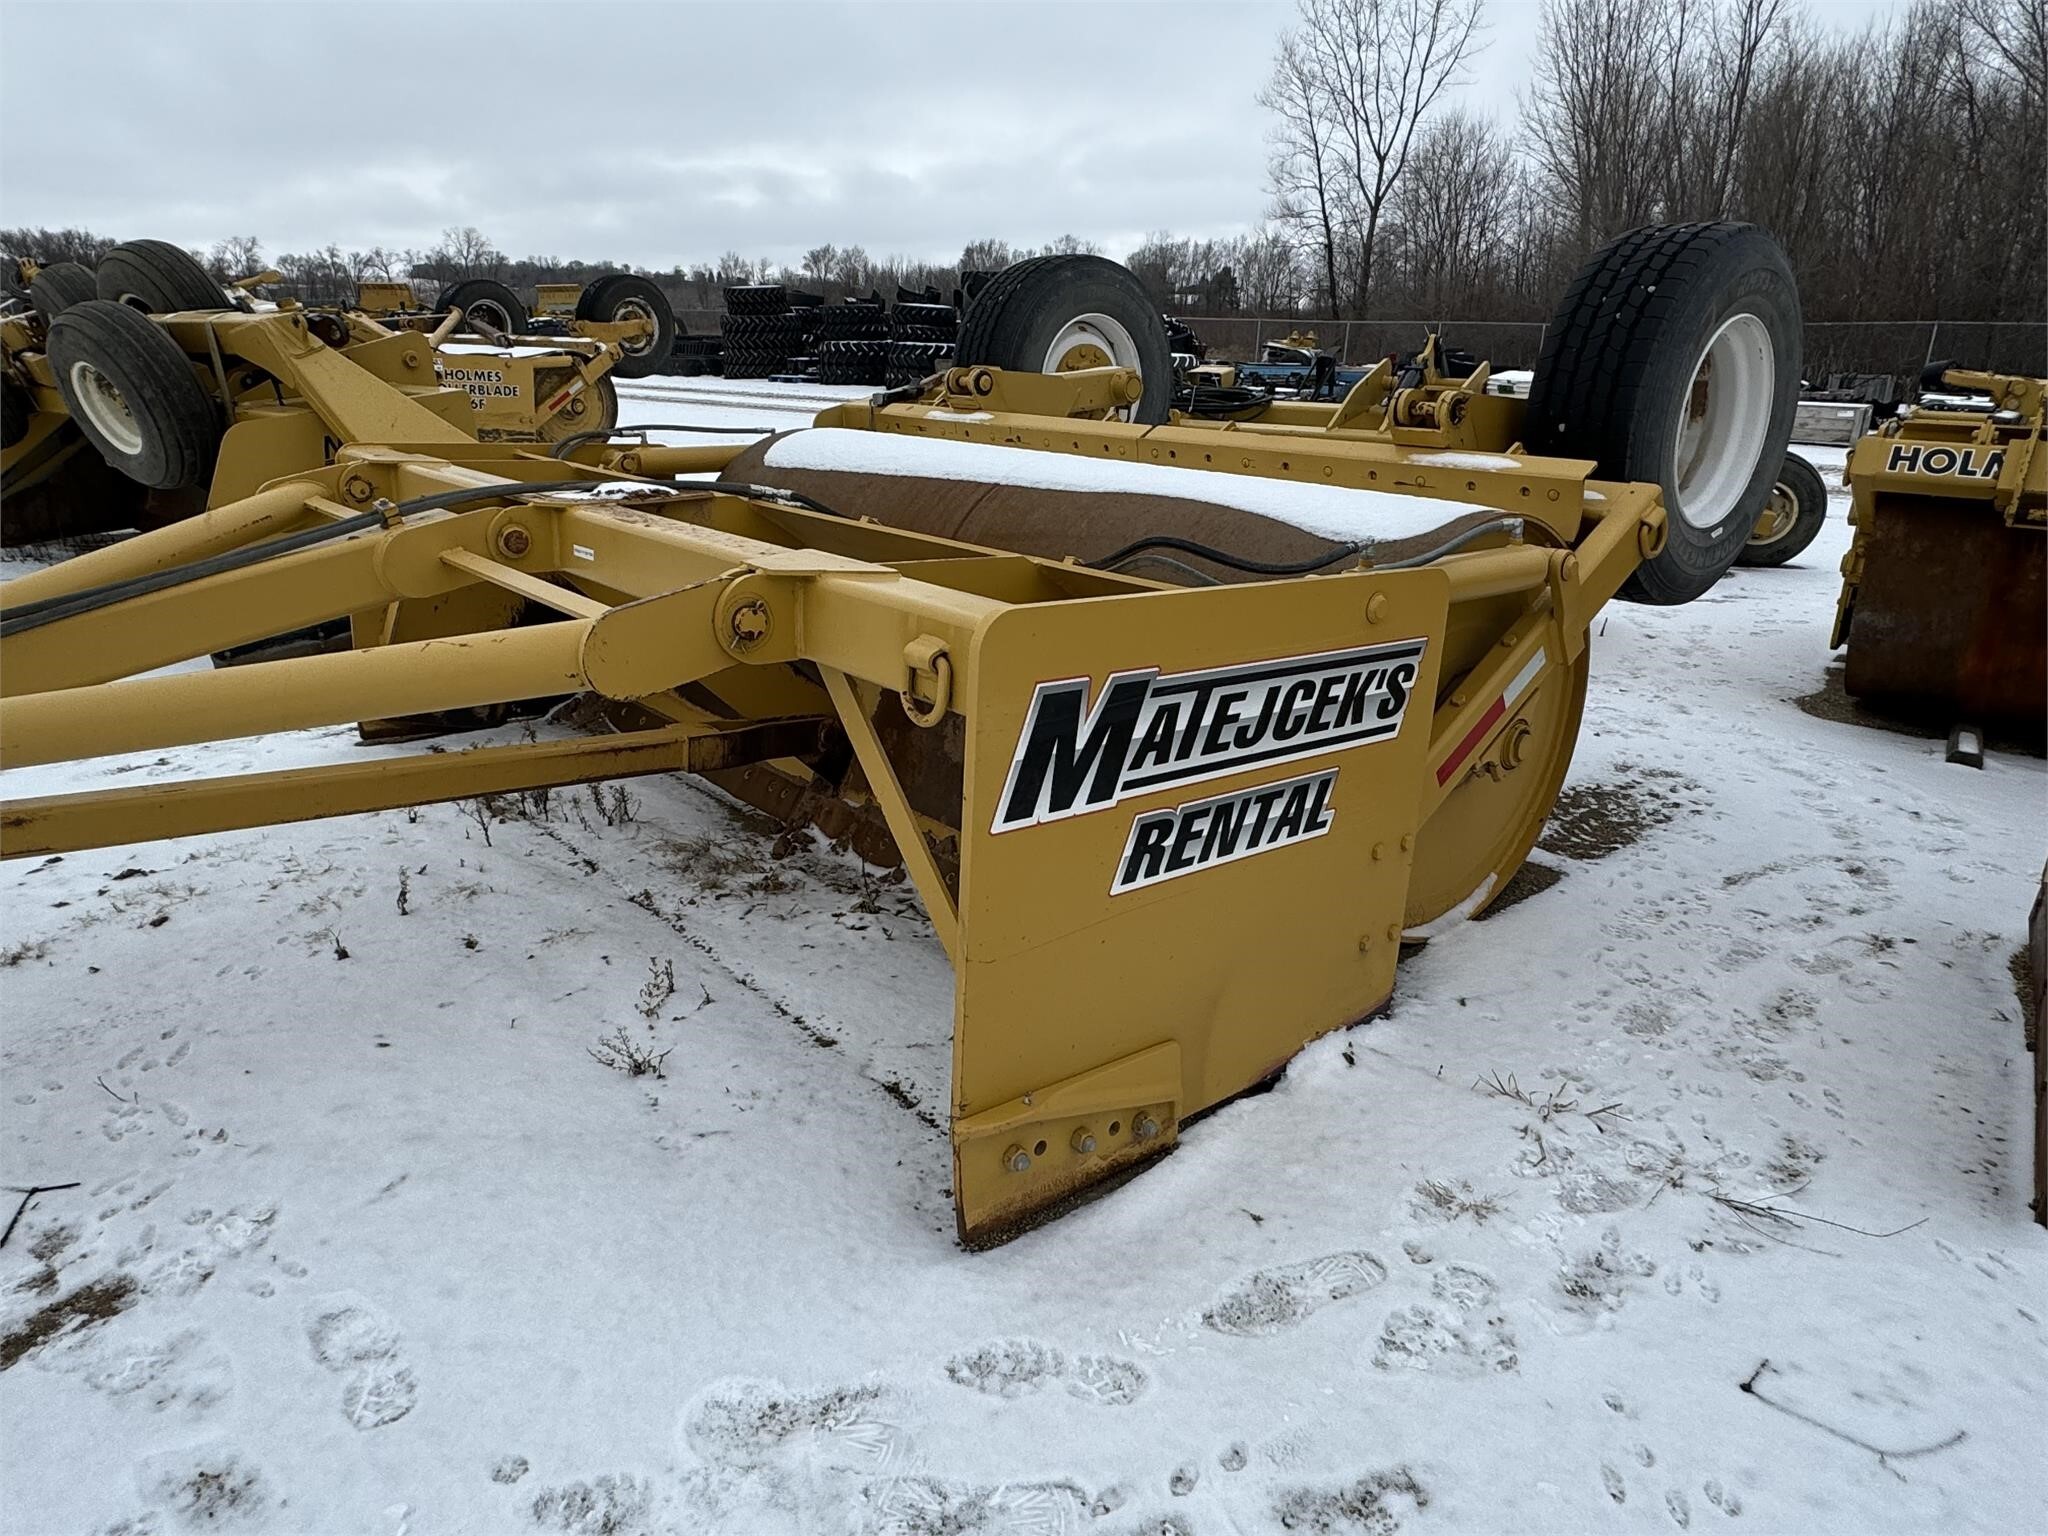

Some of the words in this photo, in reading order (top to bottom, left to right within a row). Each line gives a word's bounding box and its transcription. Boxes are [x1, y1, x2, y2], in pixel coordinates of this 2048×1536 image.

[444, 368, 502, 382] HOLMES
[1002, 662, 1416, 824] MATEJCEK'S
[1120, 777, 1332, 886] RENTAL
